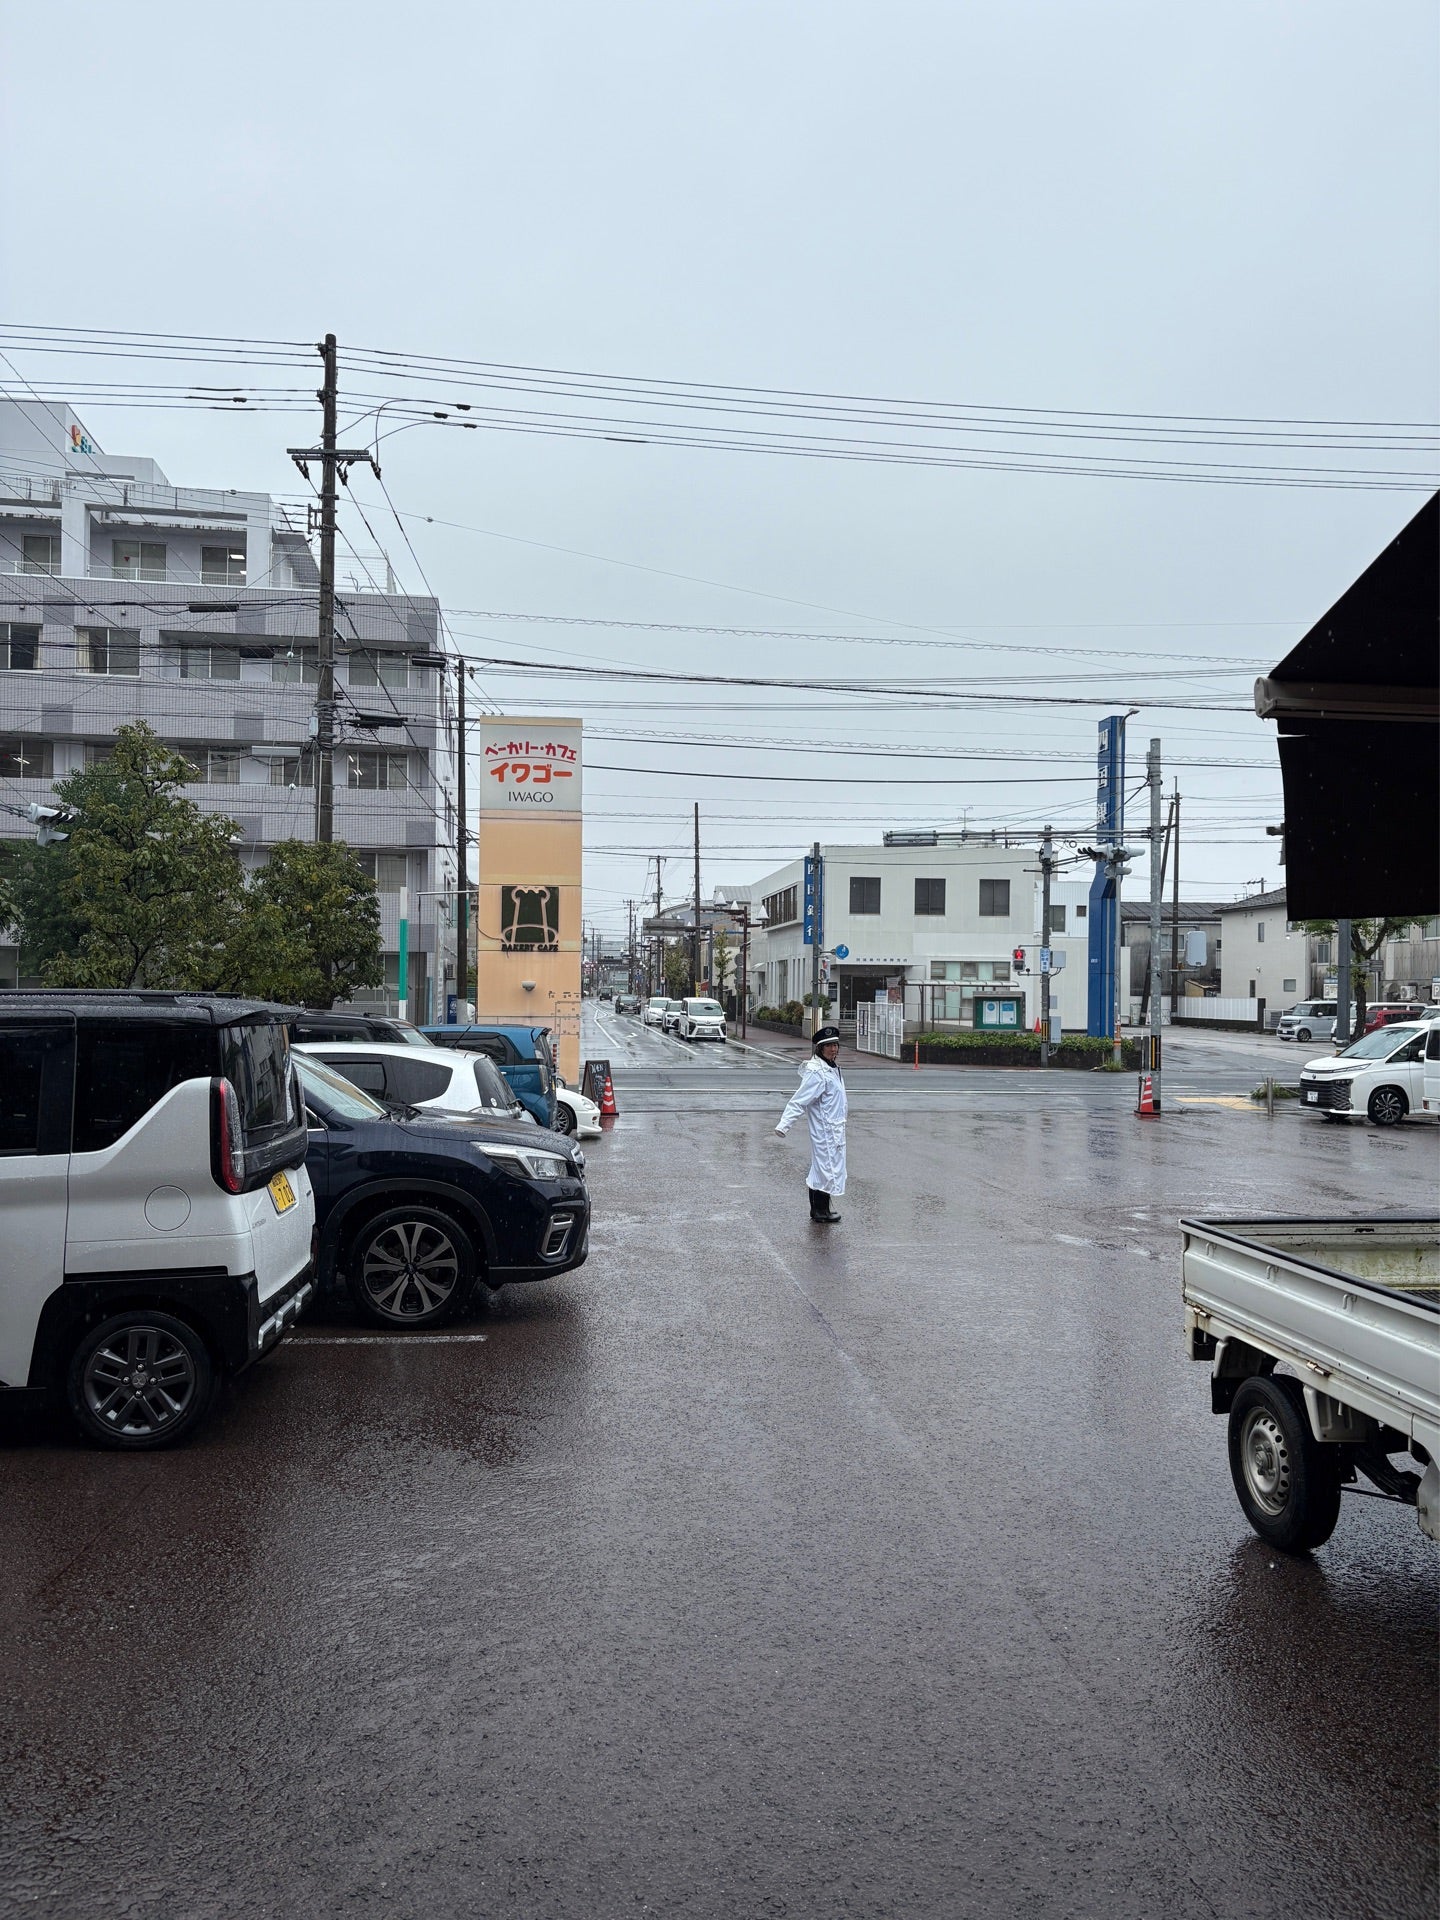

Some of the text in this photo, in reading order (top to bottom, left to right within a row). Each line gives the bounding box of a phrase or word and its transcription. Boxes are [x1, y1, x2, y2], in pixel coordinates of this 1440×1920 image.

[484, 741, 577, 761] ベーカリー・カフェ
[490, 762, 573, 784] イワゴー
[508, 791, 554, 803] IWAGO
[501, 943, 535, 952] BAKERY
